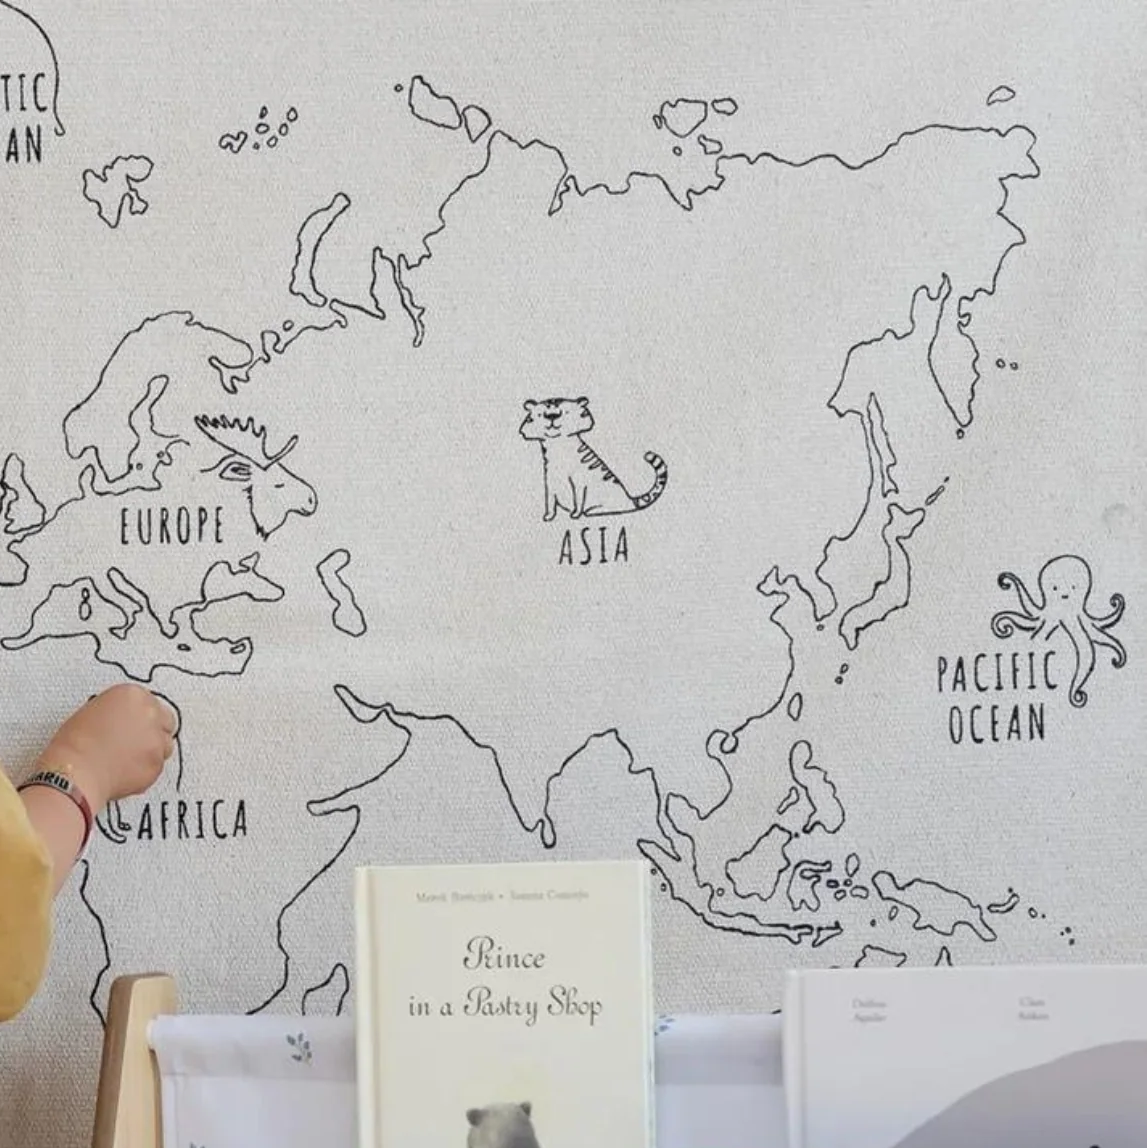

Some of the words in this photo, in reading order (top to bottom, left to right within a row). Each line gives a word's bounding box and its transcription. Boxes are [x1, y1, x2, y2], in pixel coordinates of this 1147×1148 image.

[121, 506, 223, 545] EUROPE
[559, 526, 628, 565] ASIA
[938, 650, 1059, 693] PACIFIC
[949, 703, 1044, 744] OCEAN
[137, 799, 246, 840] AFRICA
[463, 936, 545, 969] Prince
[409, 996, 429, 1016] in
[440, 1002, 452, 1016] a
[463, 986, 538, 1026] Pastry
[547, 986, 602, 1026] Shop
